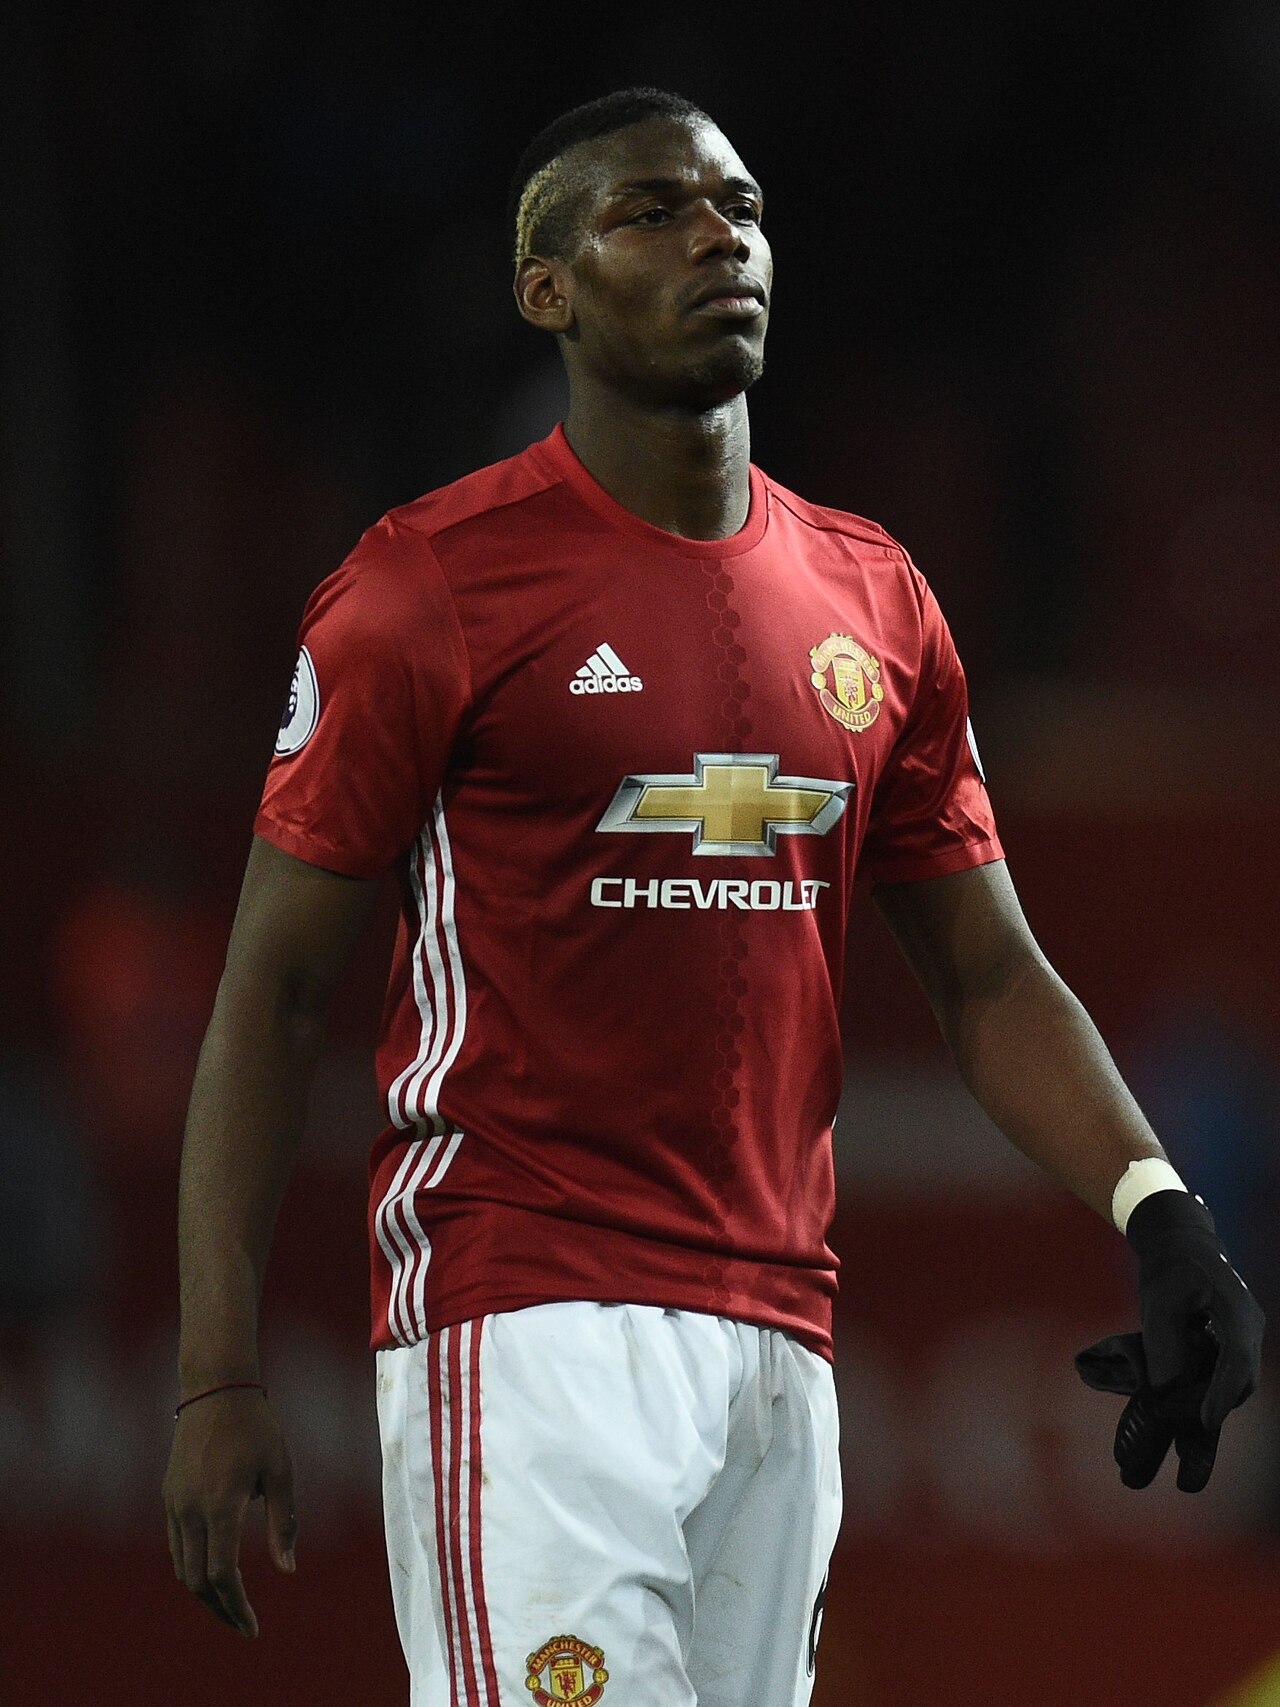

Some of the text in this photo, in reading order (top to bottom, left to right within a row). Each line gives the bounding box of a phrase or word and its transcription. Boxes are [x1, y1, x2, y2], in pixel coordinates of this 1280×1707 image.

[815, 640, 874, 675] MANCHESTER
[569, 674, 643, 695] adidas
[832, 704, 871, 724] UNITED
[590, 877, 830, 911] CHEVROLET
[532, 1640, 598, 1670] MANCHESTER
[547, 1695, 592, 1707] UNITED
